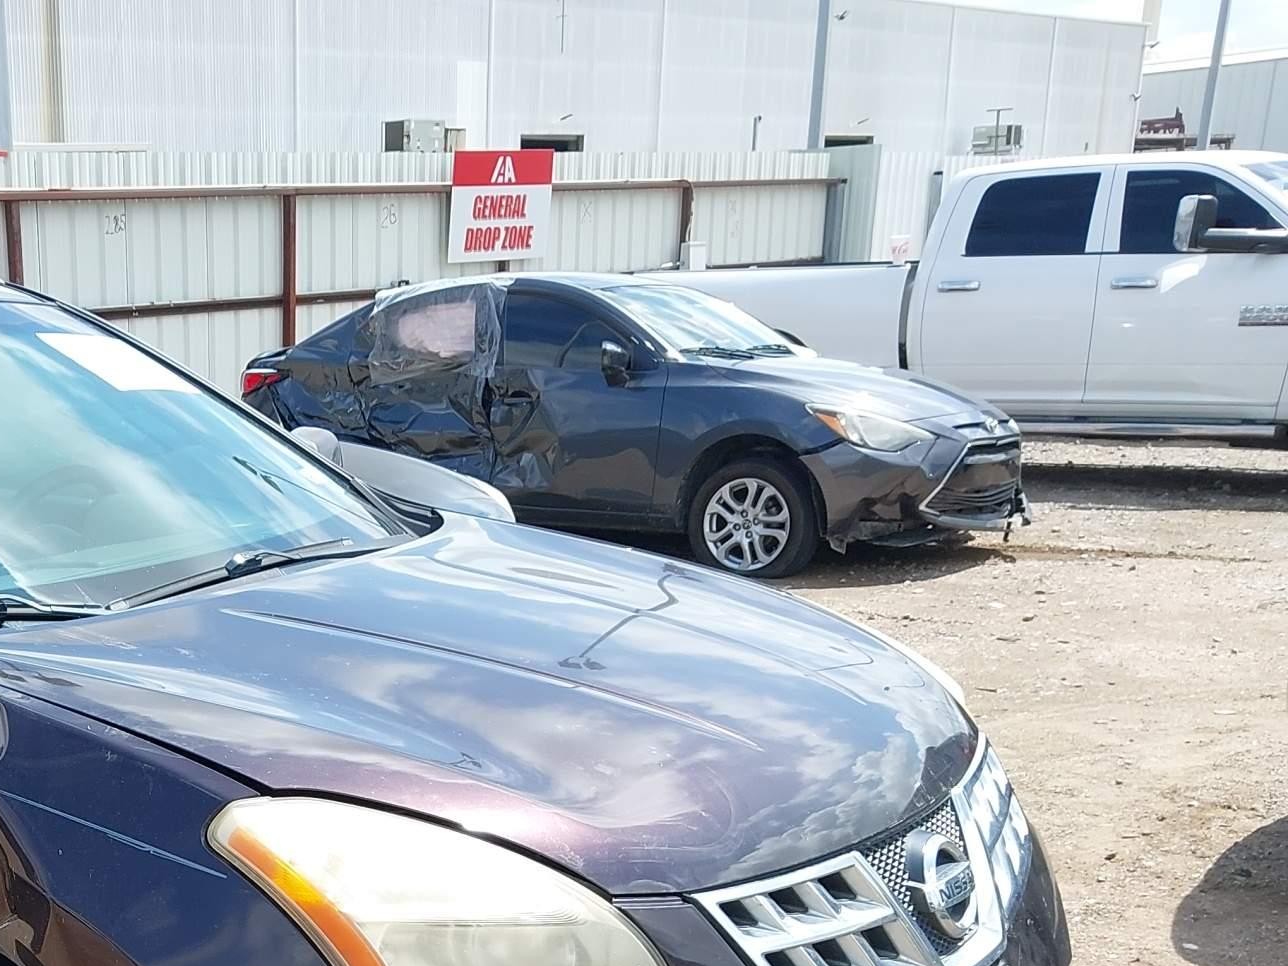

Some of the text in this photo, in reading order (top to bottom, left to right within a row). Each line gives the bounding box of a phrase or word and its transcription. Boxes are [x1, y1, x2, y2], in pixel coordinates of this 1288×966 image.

[472, 193, 528, 221] GENERAL
[463, 225, 534, 254] DROP ZONE
[938, 869, 975, 904] NISSA
